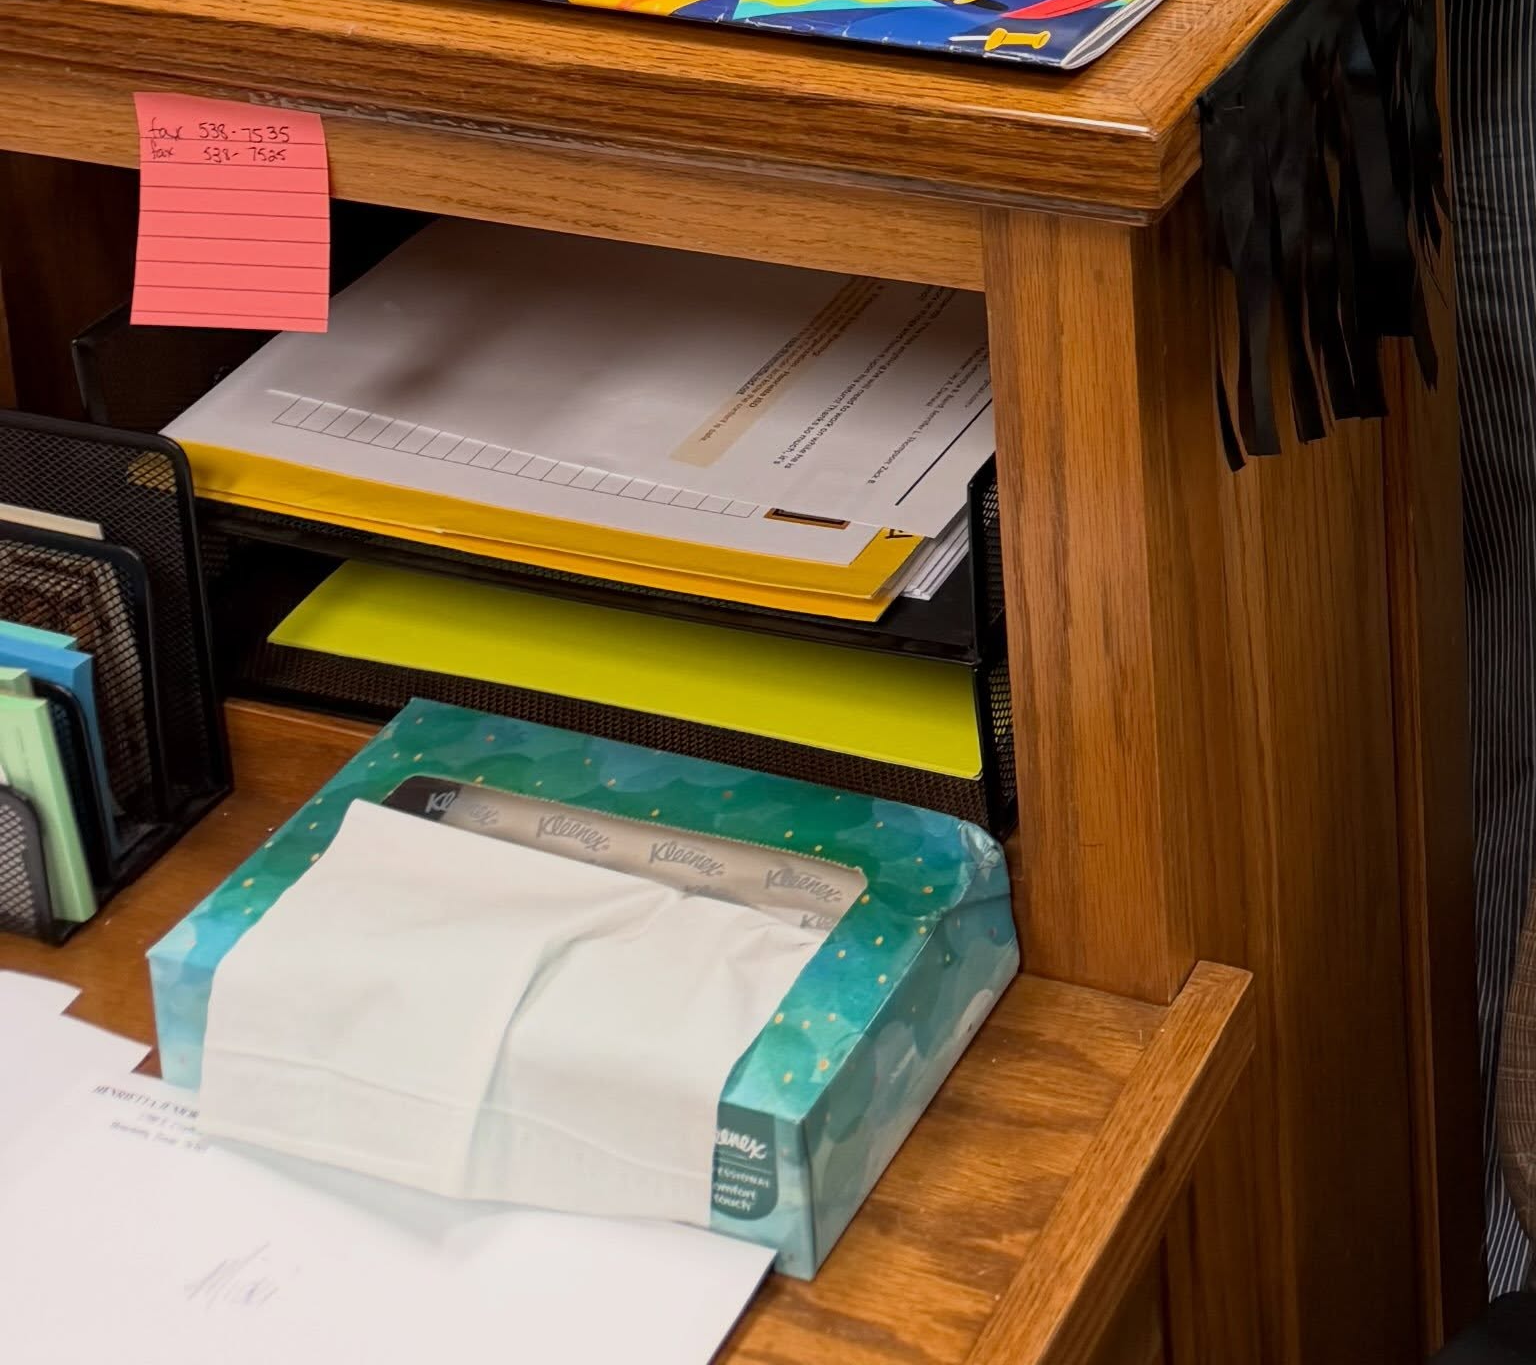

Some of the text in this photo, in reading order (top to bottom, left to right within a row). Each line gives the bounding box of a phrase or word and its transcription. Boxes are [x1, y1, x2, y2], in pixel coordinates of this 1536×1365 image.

[148, 118, 184, 141] fax
[150, 142, 176, 159] fax
[536, 813, 611, 852] Kleenex
[648, 842, 724, 877] Kleenex
[765, 868, 843, 903] Kleenex
